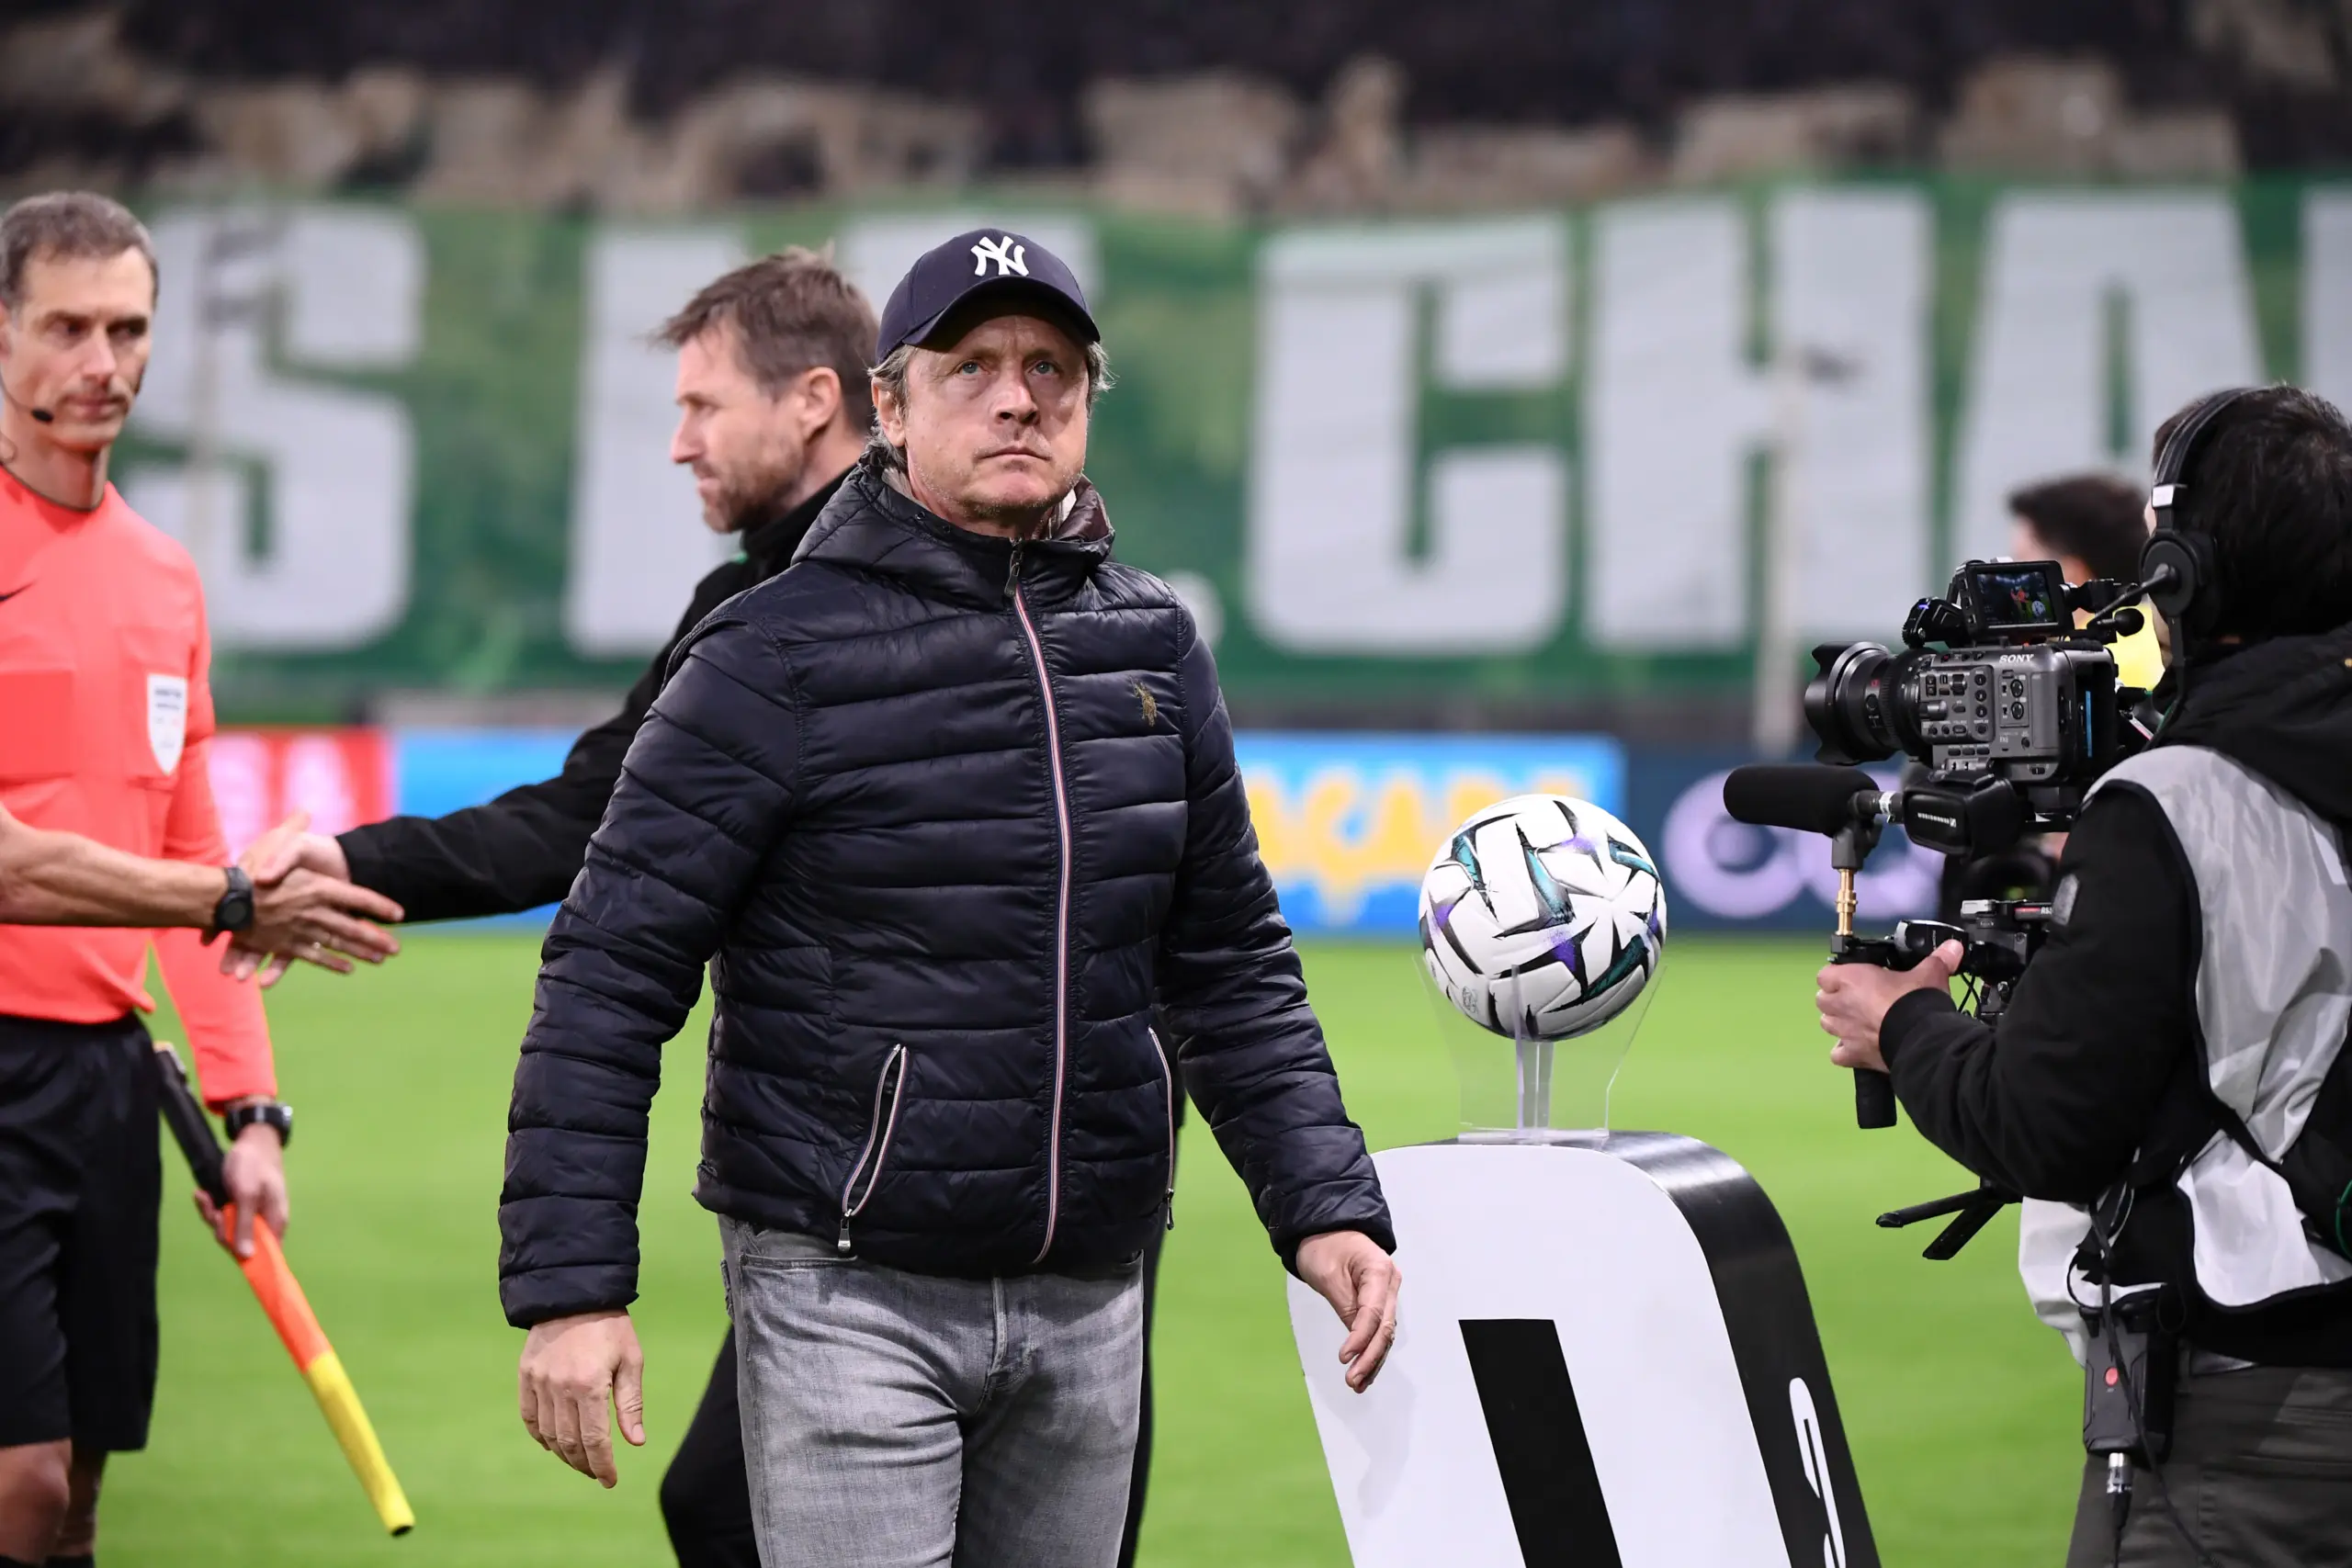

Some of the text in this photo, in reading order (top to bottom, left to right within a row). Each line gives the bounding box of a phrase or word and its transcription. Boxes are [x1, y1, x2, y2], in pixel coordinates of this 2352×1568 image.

[970, 235, 1029, 276] NY
[1248, 188, 2352, 658] CHA
[1998, 653, 2034, 663] SONY
